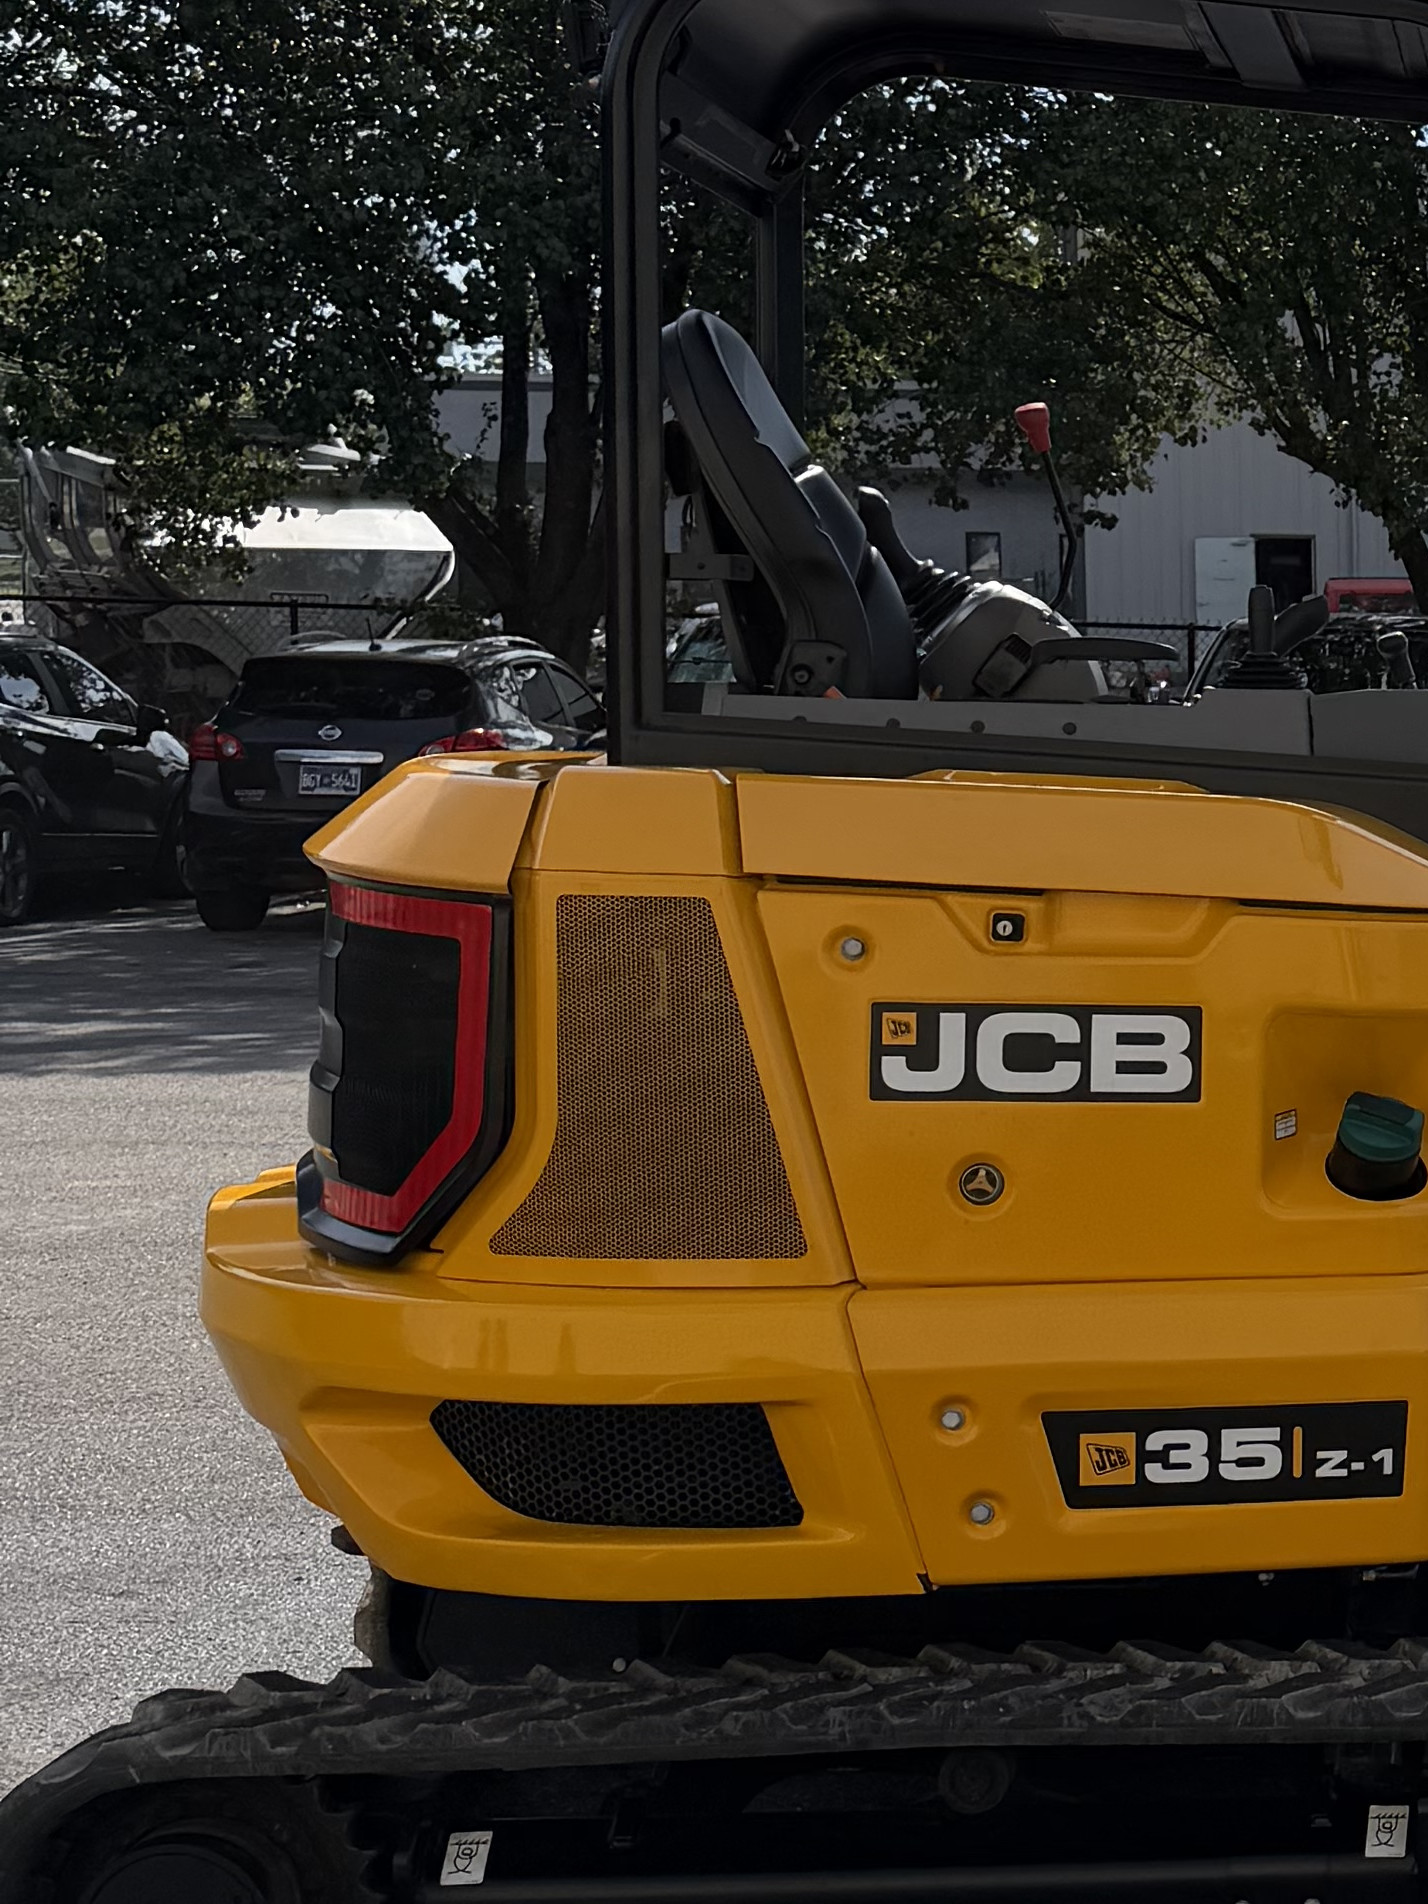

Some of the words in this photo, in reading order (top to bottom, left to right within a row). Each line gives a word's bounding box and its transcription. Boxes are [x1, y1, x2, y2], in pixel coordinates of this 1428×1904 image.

[881, 1012, 1193, 1094] JCB
[1093, 1446, 1129, 1470] JCB
[1144, 1426, 1283, 1484] 35
[1315, 1448, 1394, 1478] Z-1
